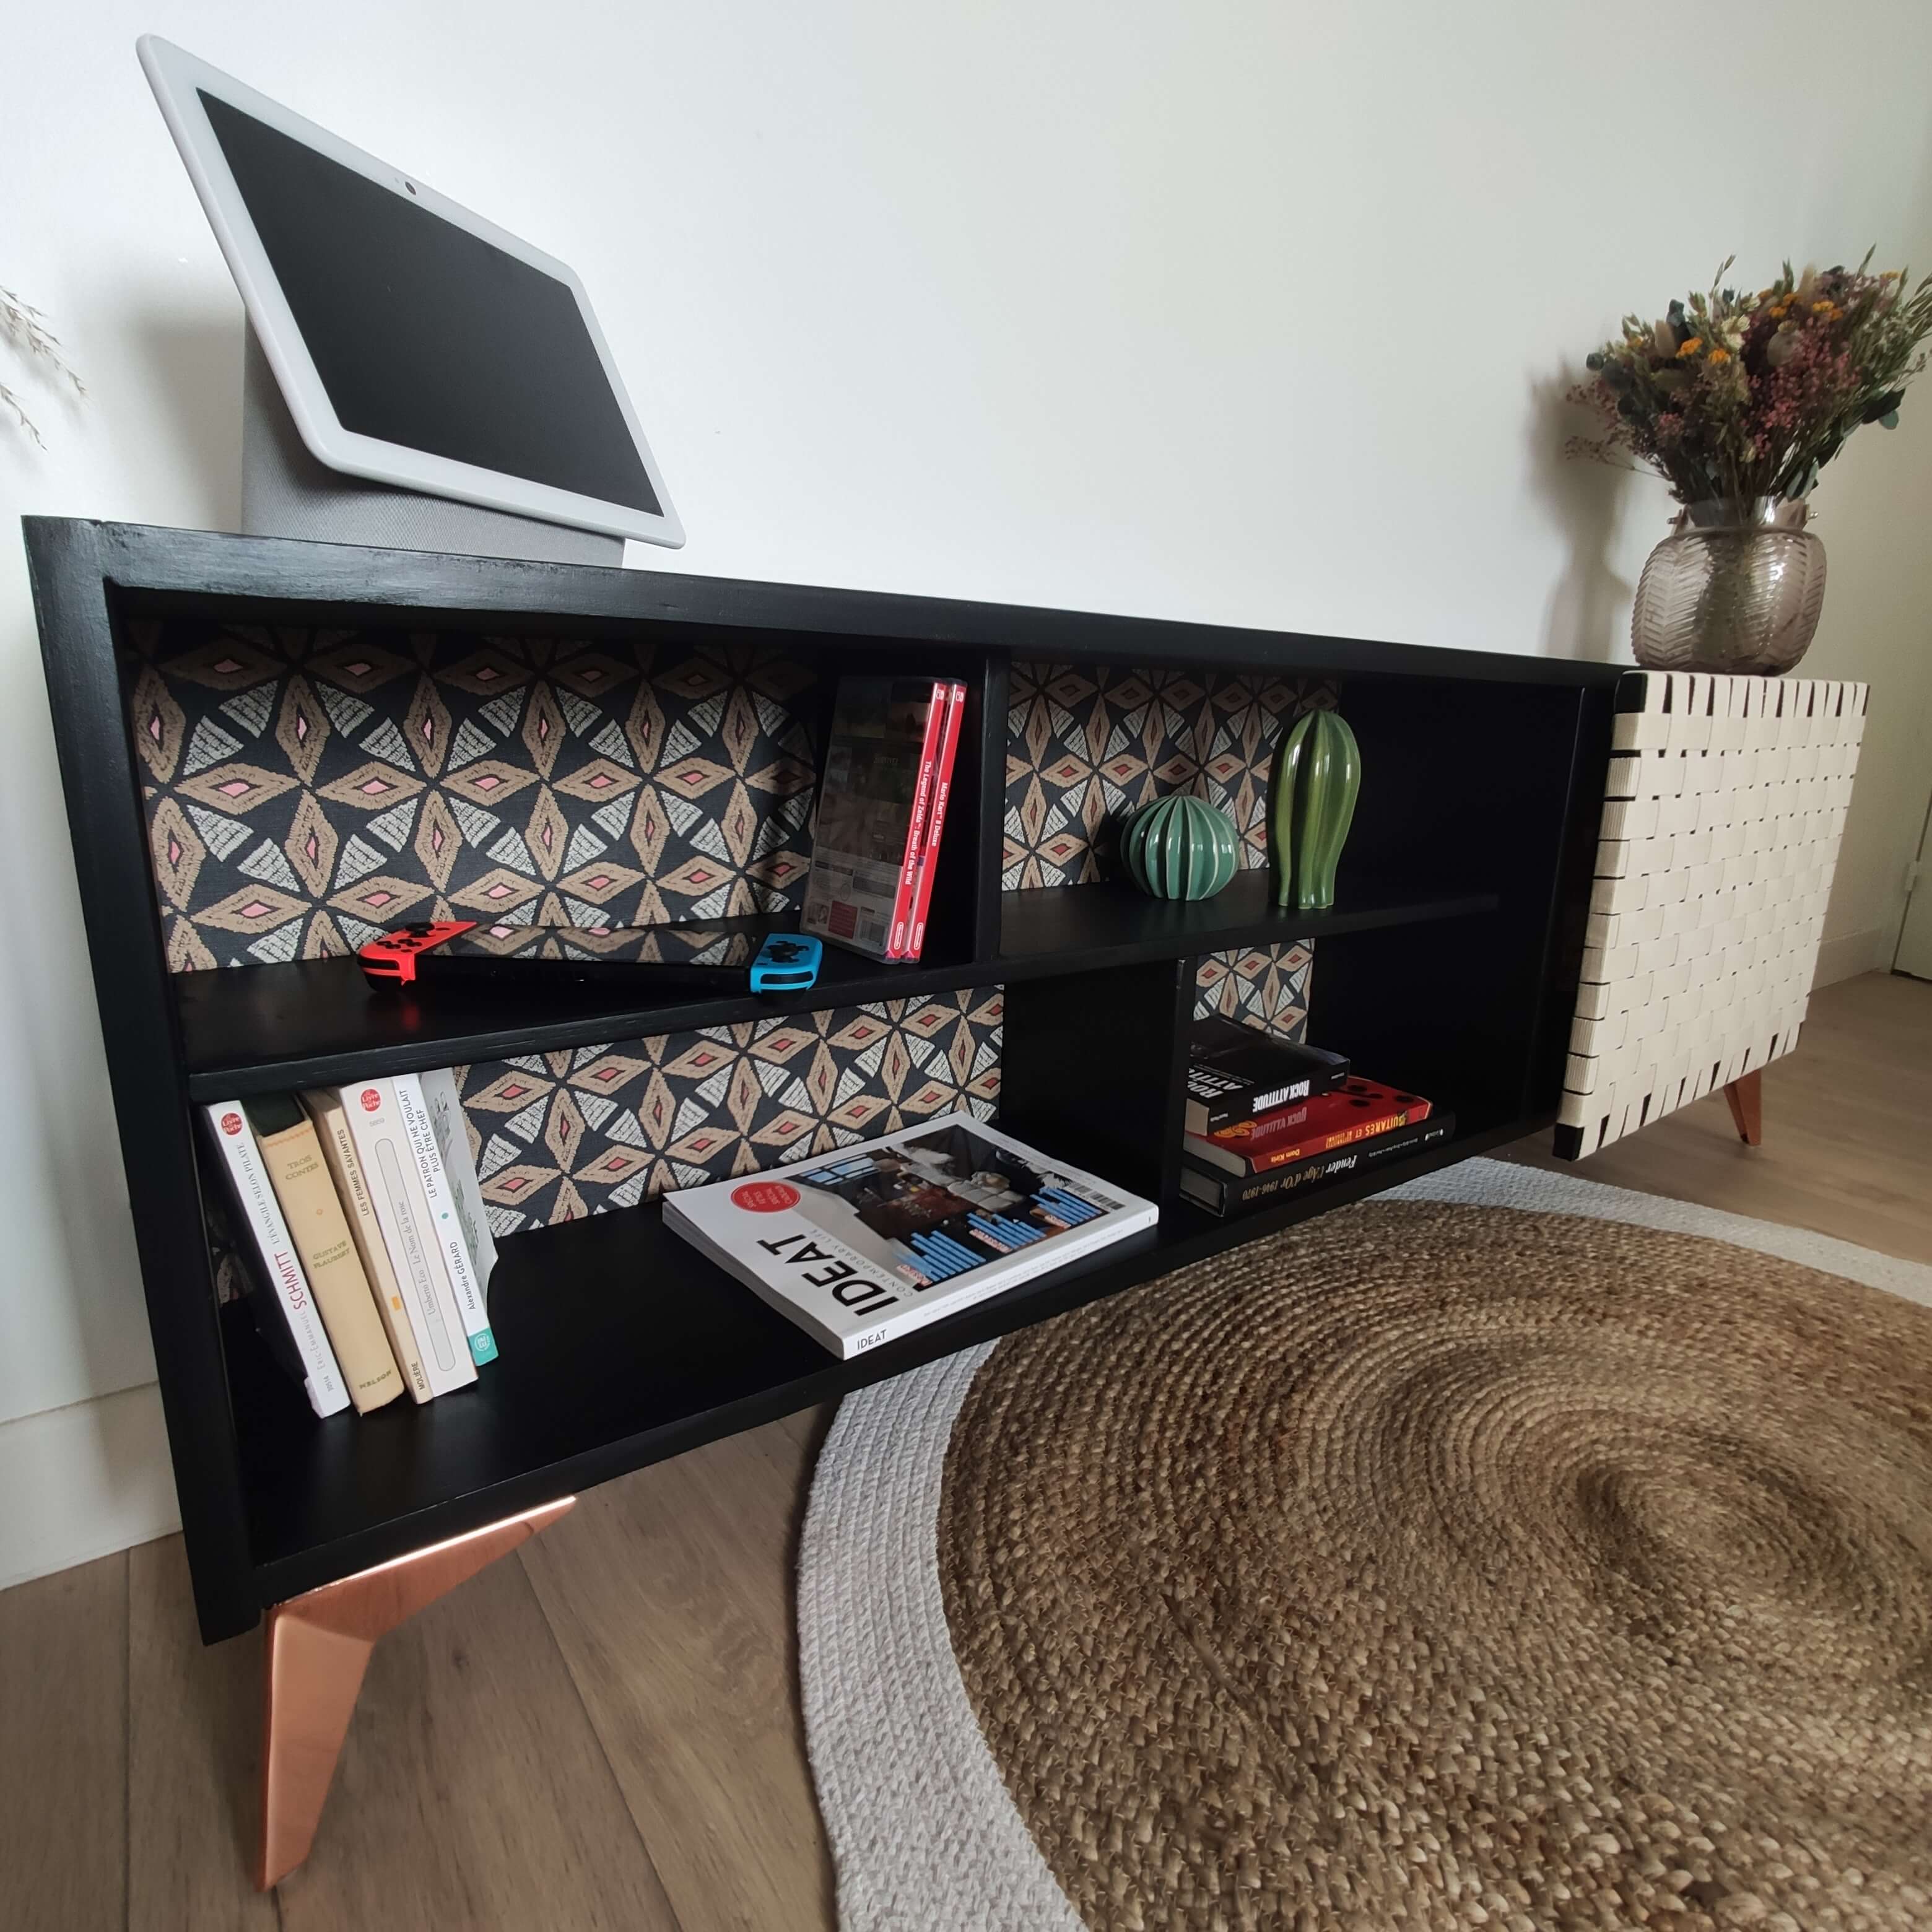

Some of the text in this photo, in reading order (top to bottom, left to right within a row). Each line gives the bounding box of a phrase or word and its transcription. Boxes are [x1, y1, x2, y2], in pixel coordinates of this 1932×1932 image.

[920, 773, 929, 797] Legend
[939, 782, 947, 800] Mario
[912, 830, 920, 851] Breath
[931, 825, 941, 847] Deluxe
[1253, 1079, 1310, 1113] ROCK ATTITUDE
[399, 1090, 437, 1198] LE PATRON QUI NE VOULAIT
[416, 1110, 441, 1173] PLUS ÊTRE CHEF
[237, 1142, 253, 1173] PILATE
[287, 1155, 312, 1170] TROIS
[1286, 1149, 1300, 1159] Dom
[1326, 1155, 1357, 1173] Fender
[285, 1164, 319, 1180] CONTES
[337, 1129, 370, 1216] LES FEMMES SAVANTES
[248, 1173, 263, 1200] SELON
[399, 1201, 407, 1217] rose
[313, 1242, 347, 1260] GUSTAVE
[407, 1234, 419, 1256] Nom
[313, 1249, 351, 1269] FLAUBERT
[414, 1256, 422, 1265] Le
[274, 1251, 307, 1310] SCHMITT
[419, 1269, 428, 1284] Eco
[450, 1242, 476, 1310] Alexandre GÉRARD
[756, 1234, 900, 1316] IDEAT
[832, 1245, 913, 1297] CONTEMPORARY
[422, 1283, 436, 1315] Umberto
[857, 1328, 887, 1350] IDEAT
[359, 1369, 392, 1390] NELSON
[411, 1362, 425, 1390] MOLIÈRE
